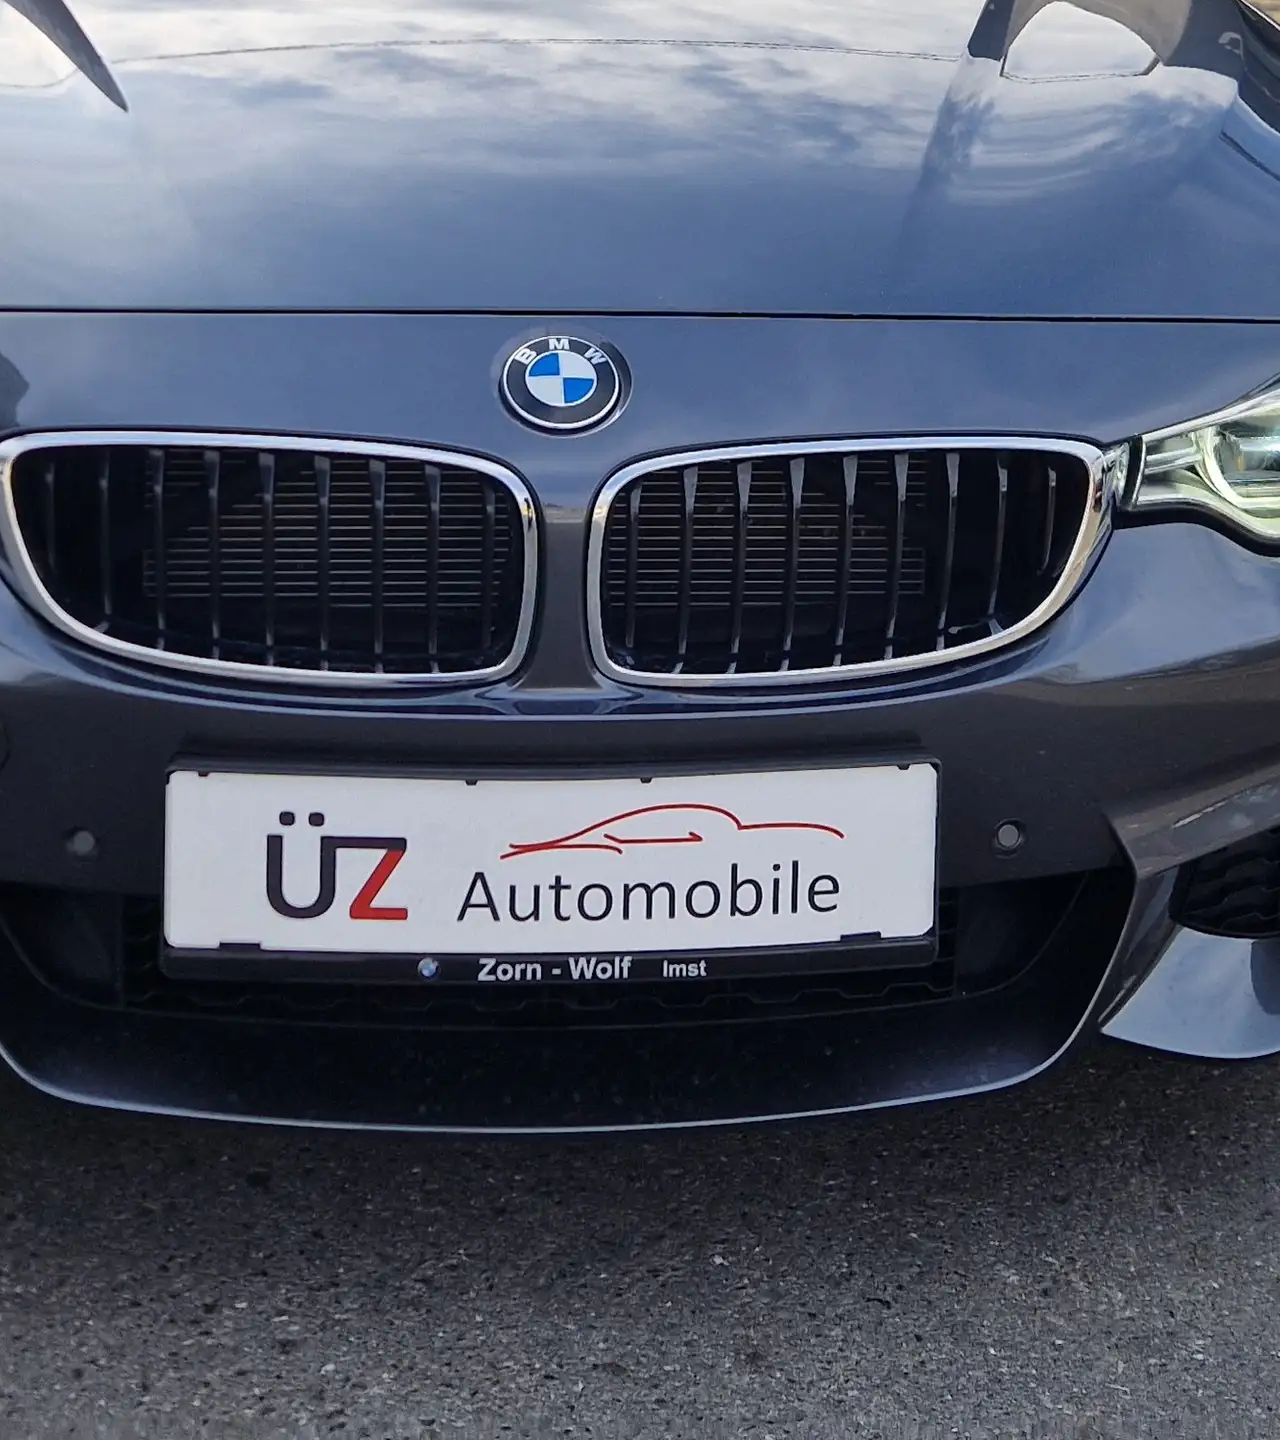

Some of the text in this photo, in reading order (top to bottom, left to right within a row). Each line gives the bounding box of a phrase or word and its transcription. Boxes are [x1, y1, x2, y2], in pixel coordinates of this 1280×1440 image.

[514, 338, 608, 365] BMW
[265, 811, 842, 923] ÜZ Automobile
[477, 957, 542, 982] Zorn
[568, 956, 633, 980] Wolf
[662, 959, 707, 978] Imst
